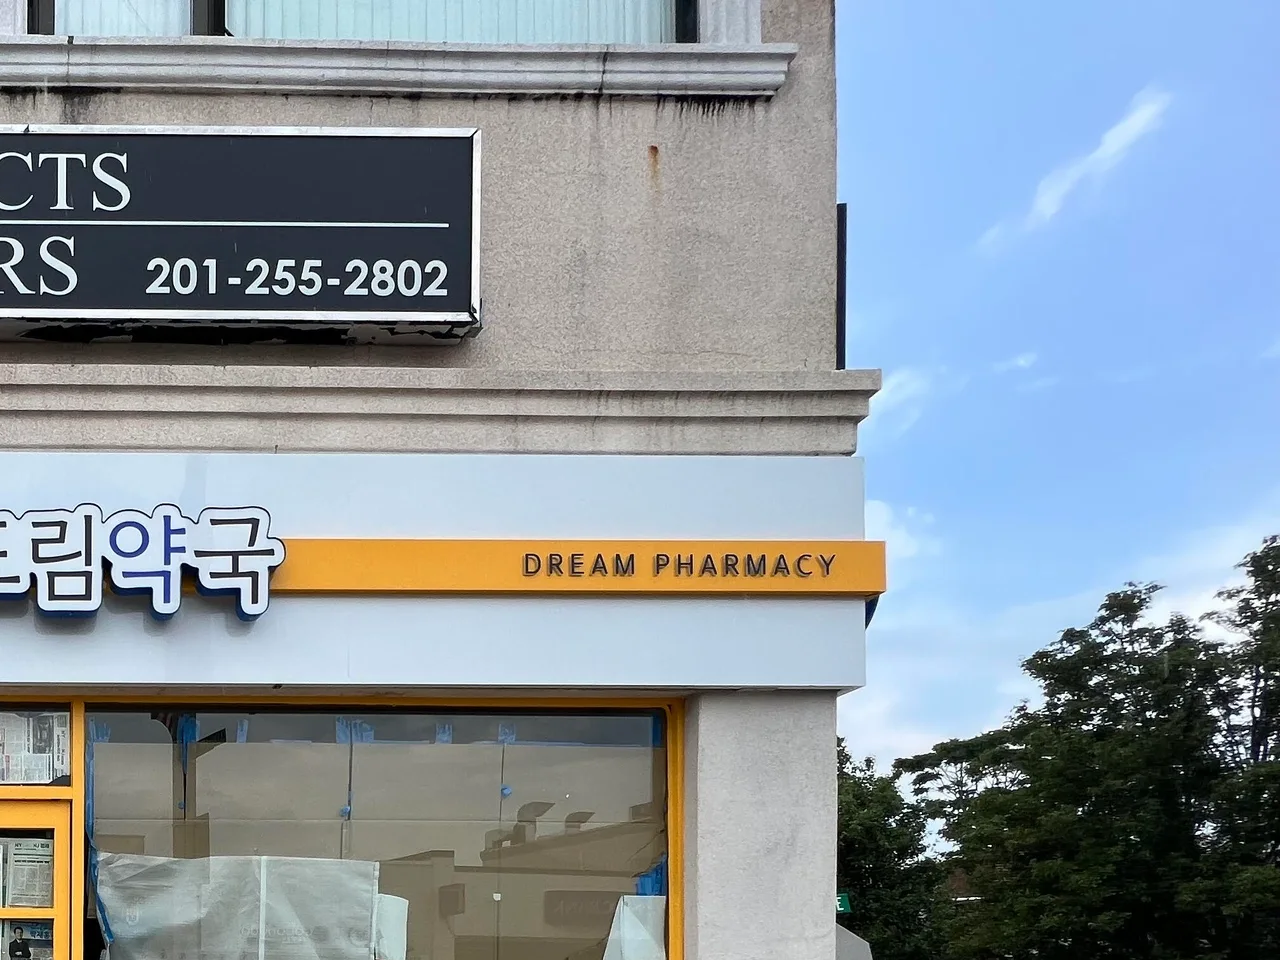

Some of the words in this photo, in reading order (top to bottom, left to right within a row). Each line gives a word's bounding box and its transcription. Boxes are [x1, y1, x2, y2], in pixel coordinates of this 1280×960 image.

[145, 257, 448, 298] 201-255-2802
[523, 553, 635, 576] DREAM
[652, 553, 837, 577] PHARMACY
